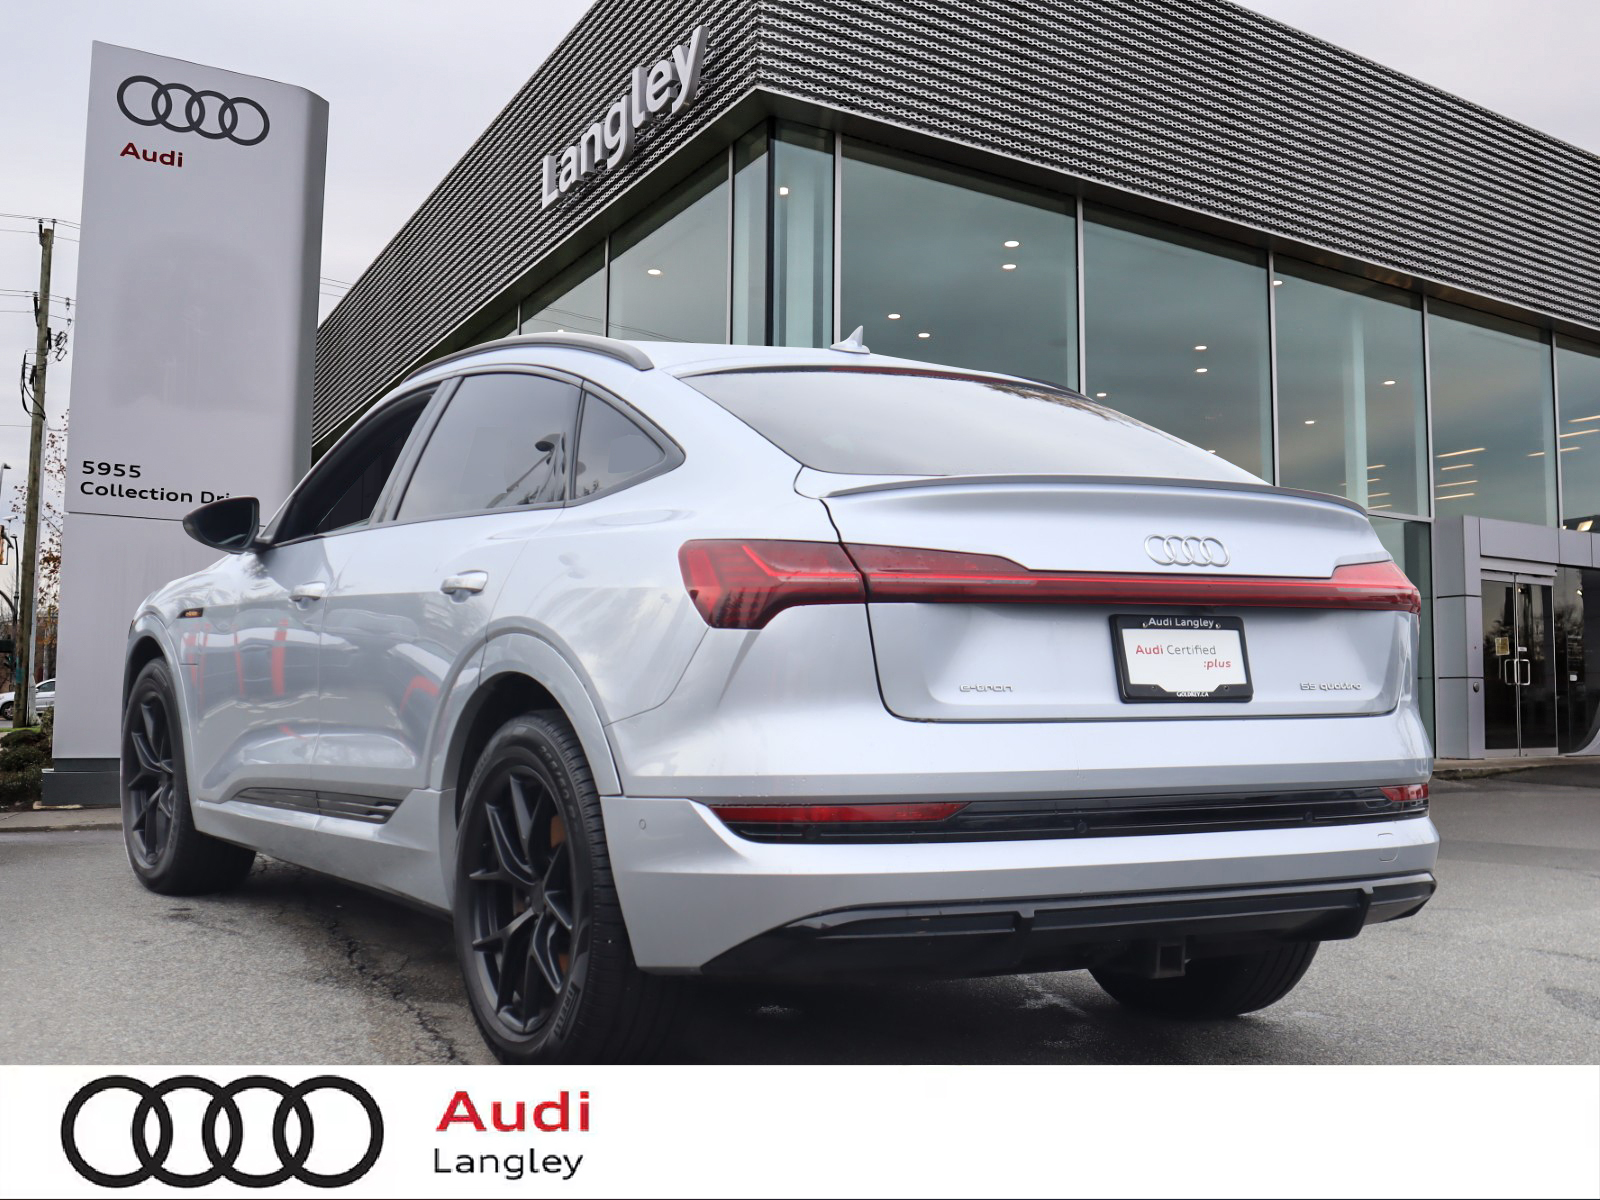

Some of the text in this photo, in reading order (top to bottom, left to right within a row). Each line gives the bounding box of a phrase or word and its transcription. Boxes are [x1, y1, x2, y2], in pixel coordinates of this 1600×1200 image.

[541, 24, 710, 209] Langley
[120, 142, 183, 167] Audi
[82, 460, 141, 478] 5955
[80, 481, 230, 504] Collection Dri
[1148, 617, 1214, 629] Audi Langley
[1135, 644, 1216, 655] Audi Certified
[959, 684, 1013, 692] e-tron
[1300, 682, 1361, 691] 55 quattro
